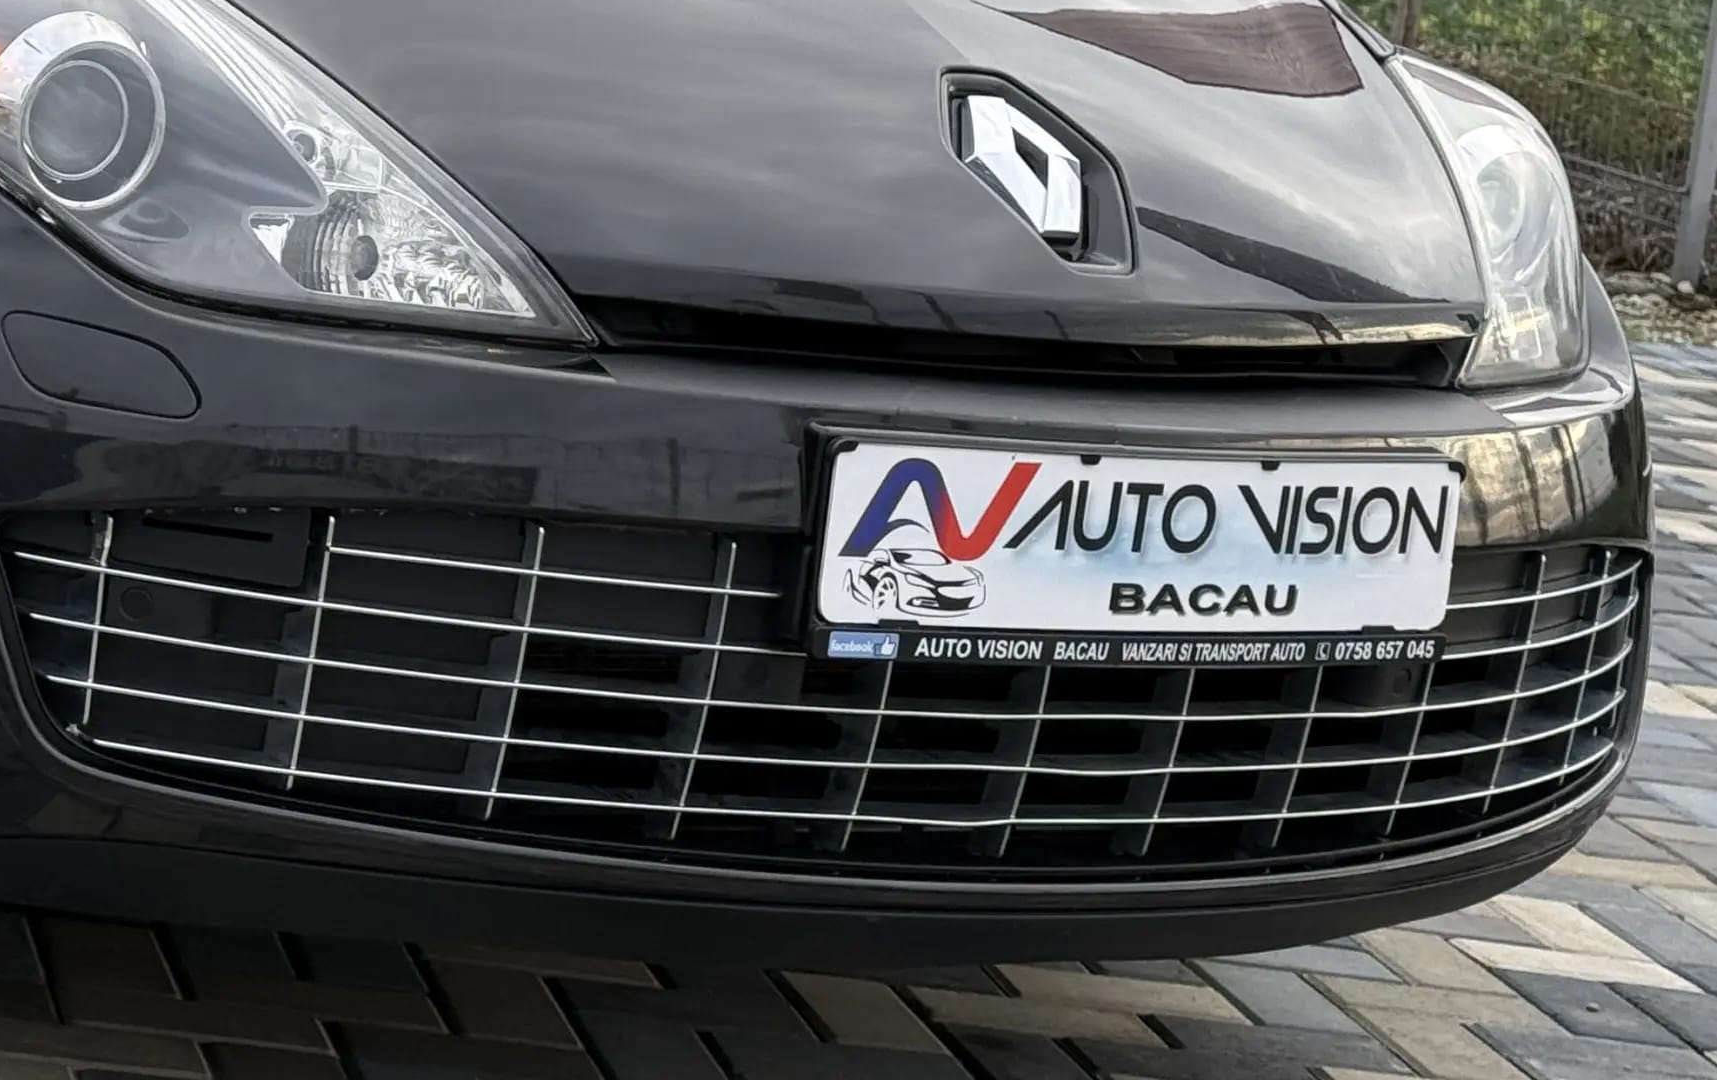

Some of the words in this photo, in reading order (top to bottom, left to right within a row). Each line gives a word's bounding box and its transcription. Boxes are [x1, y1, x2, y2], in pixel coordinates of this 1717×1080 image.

[1003, 479, 1218, 554] AUTO
[1237, 483, 1450, 557] VISION
[1109, 582, 1299, 617] BACAU
[831, 639, 874, 653] facebook
[914, 637, 971, 658] AUTO
[977, 639, 1044, 660] VISION
[1053, 642, 1110, 661] BACAU
[1121, 642, 1177, 661] VANZARI
[1194, 642, 1270, 661] TRANSPORT
[1271, 642, 1306, 661] AUTO
[1334, 641, 1372, 660] 0758
[1375, 640, 1403, 659] 657
[1406, 639, 1434, 659] 045
